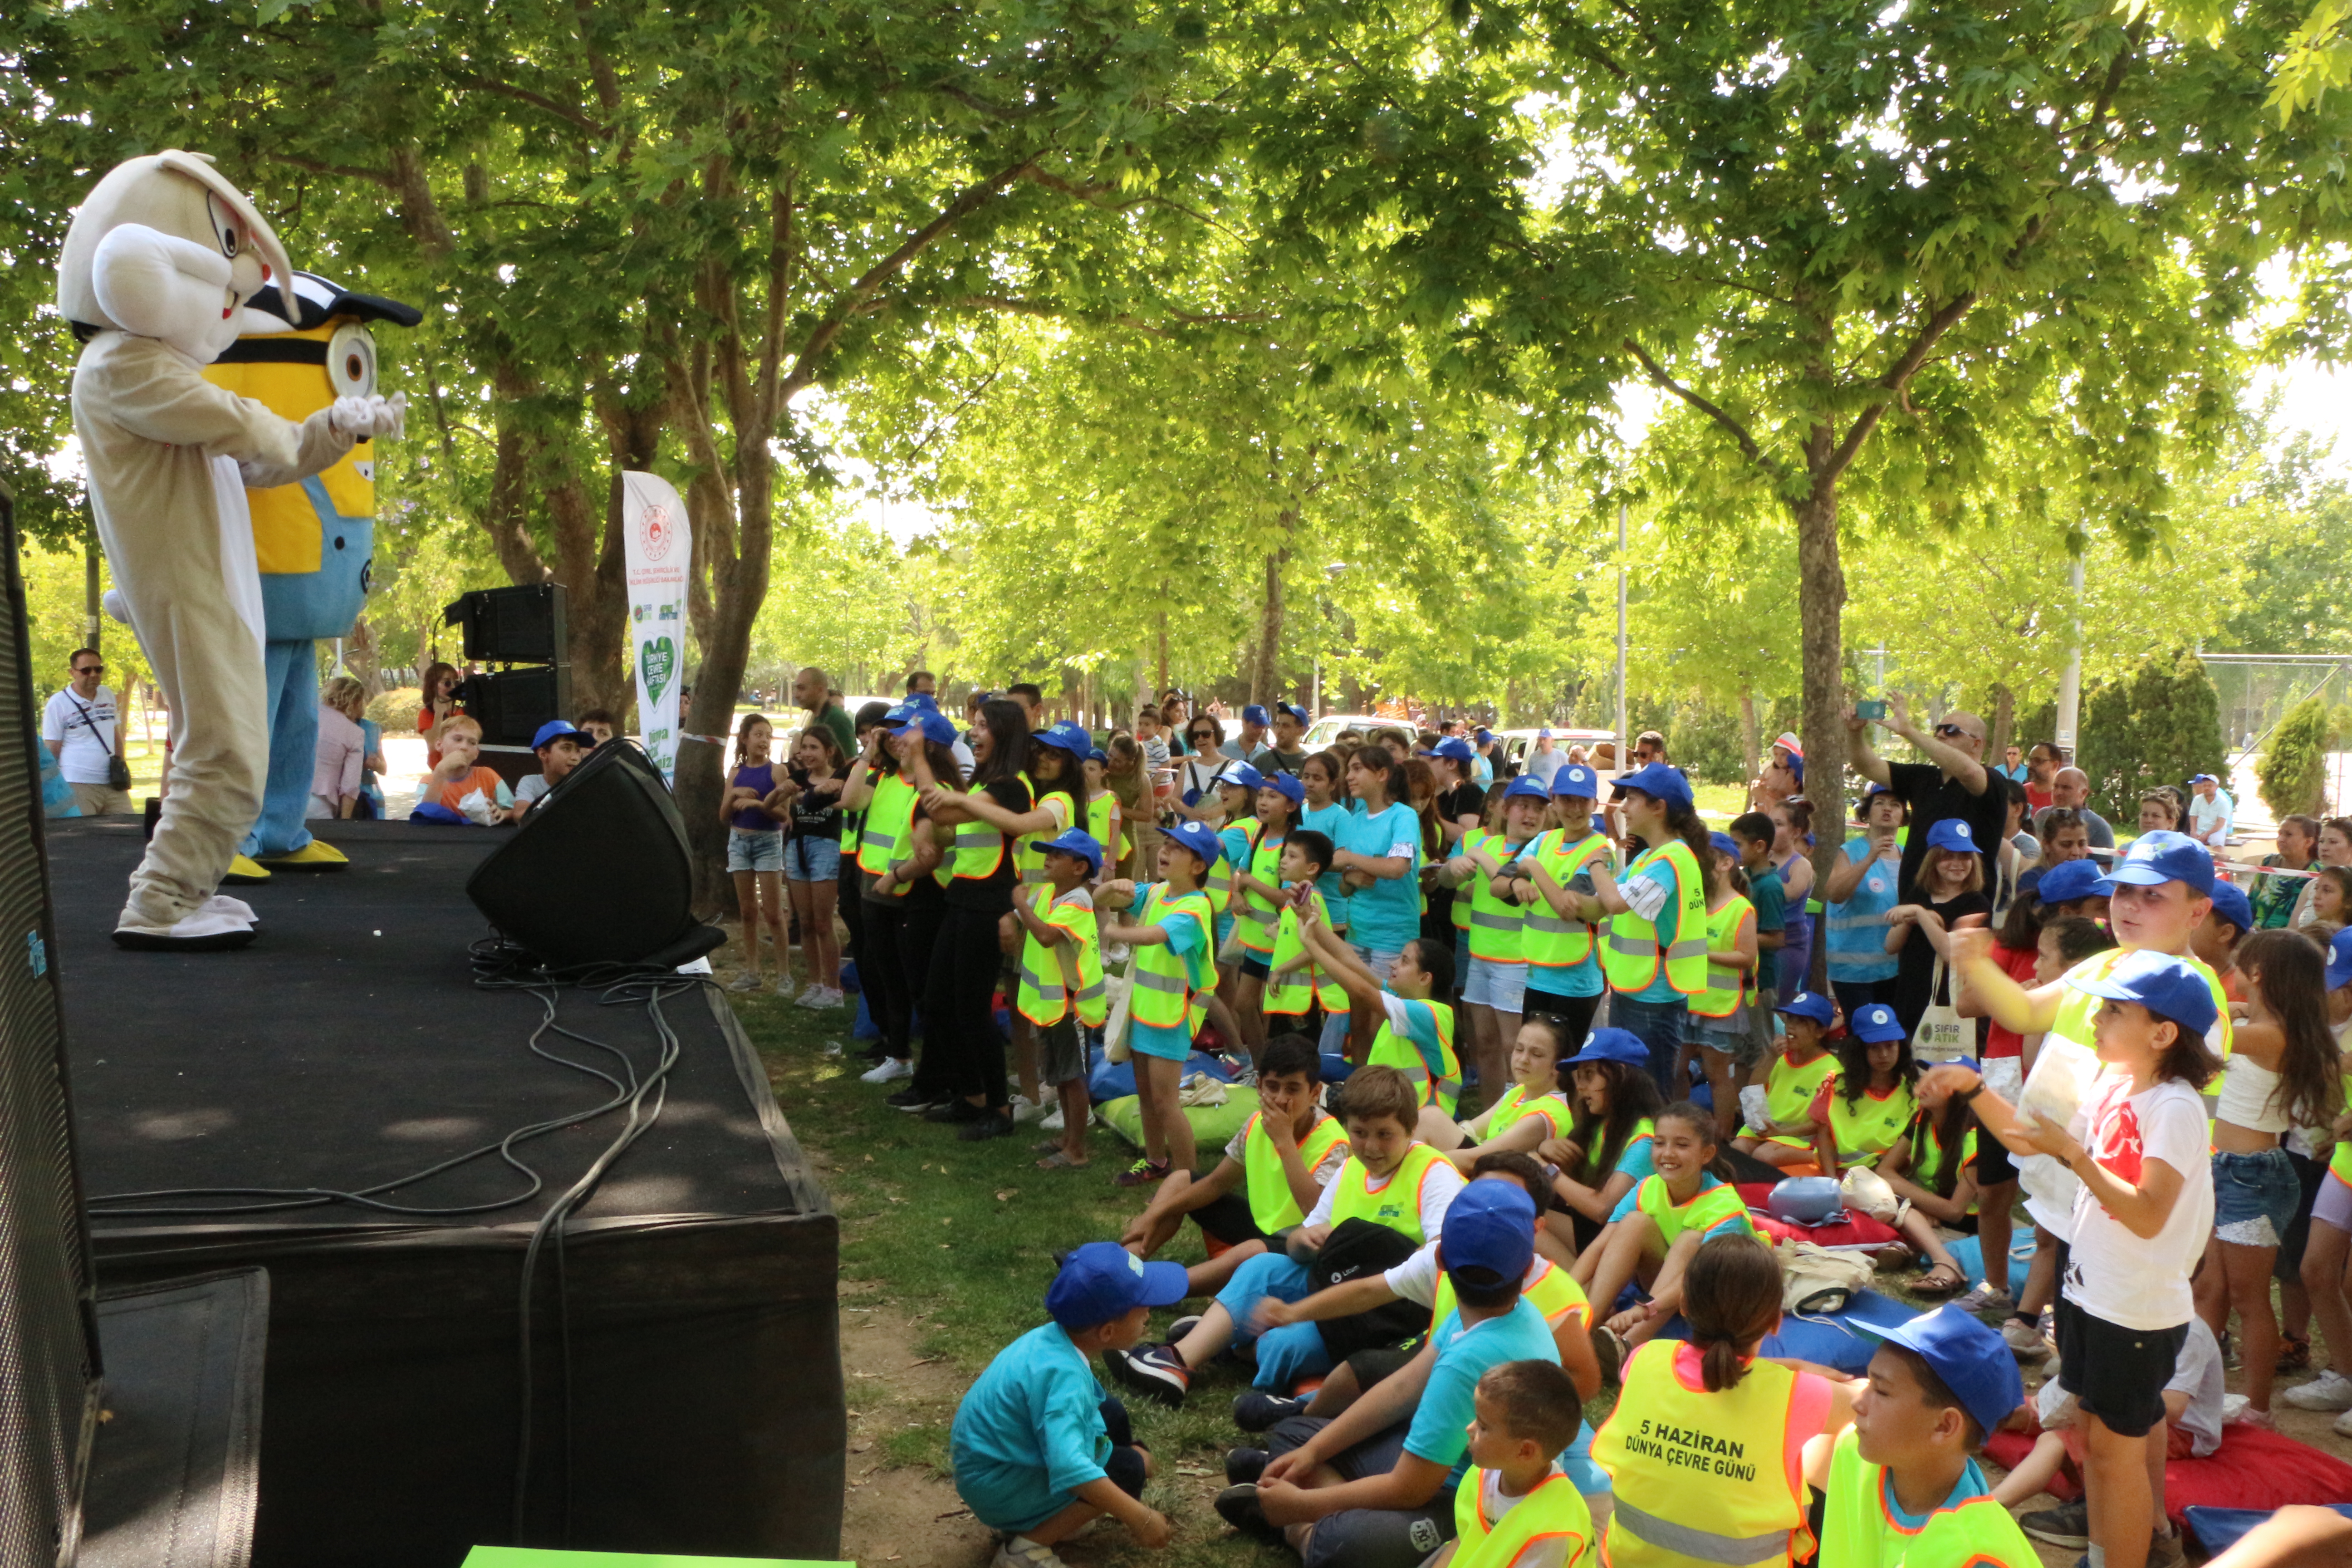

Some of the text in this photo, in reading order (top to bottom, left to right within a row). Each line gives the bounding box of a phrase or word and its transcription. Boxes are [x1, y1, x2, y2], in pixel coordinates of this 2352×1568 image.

[1694, 888, 1700, 897] 5
[1935, 1024, 1960, 1033] SIFIR
[1935, 1034, 1959, 1043] ATIK
[1640, 1420, 1744, 1459] 5 HAZİRAN
[1626, 1435, 1756, 1482] DÜNYA ÇEVRE GÜNÜ
